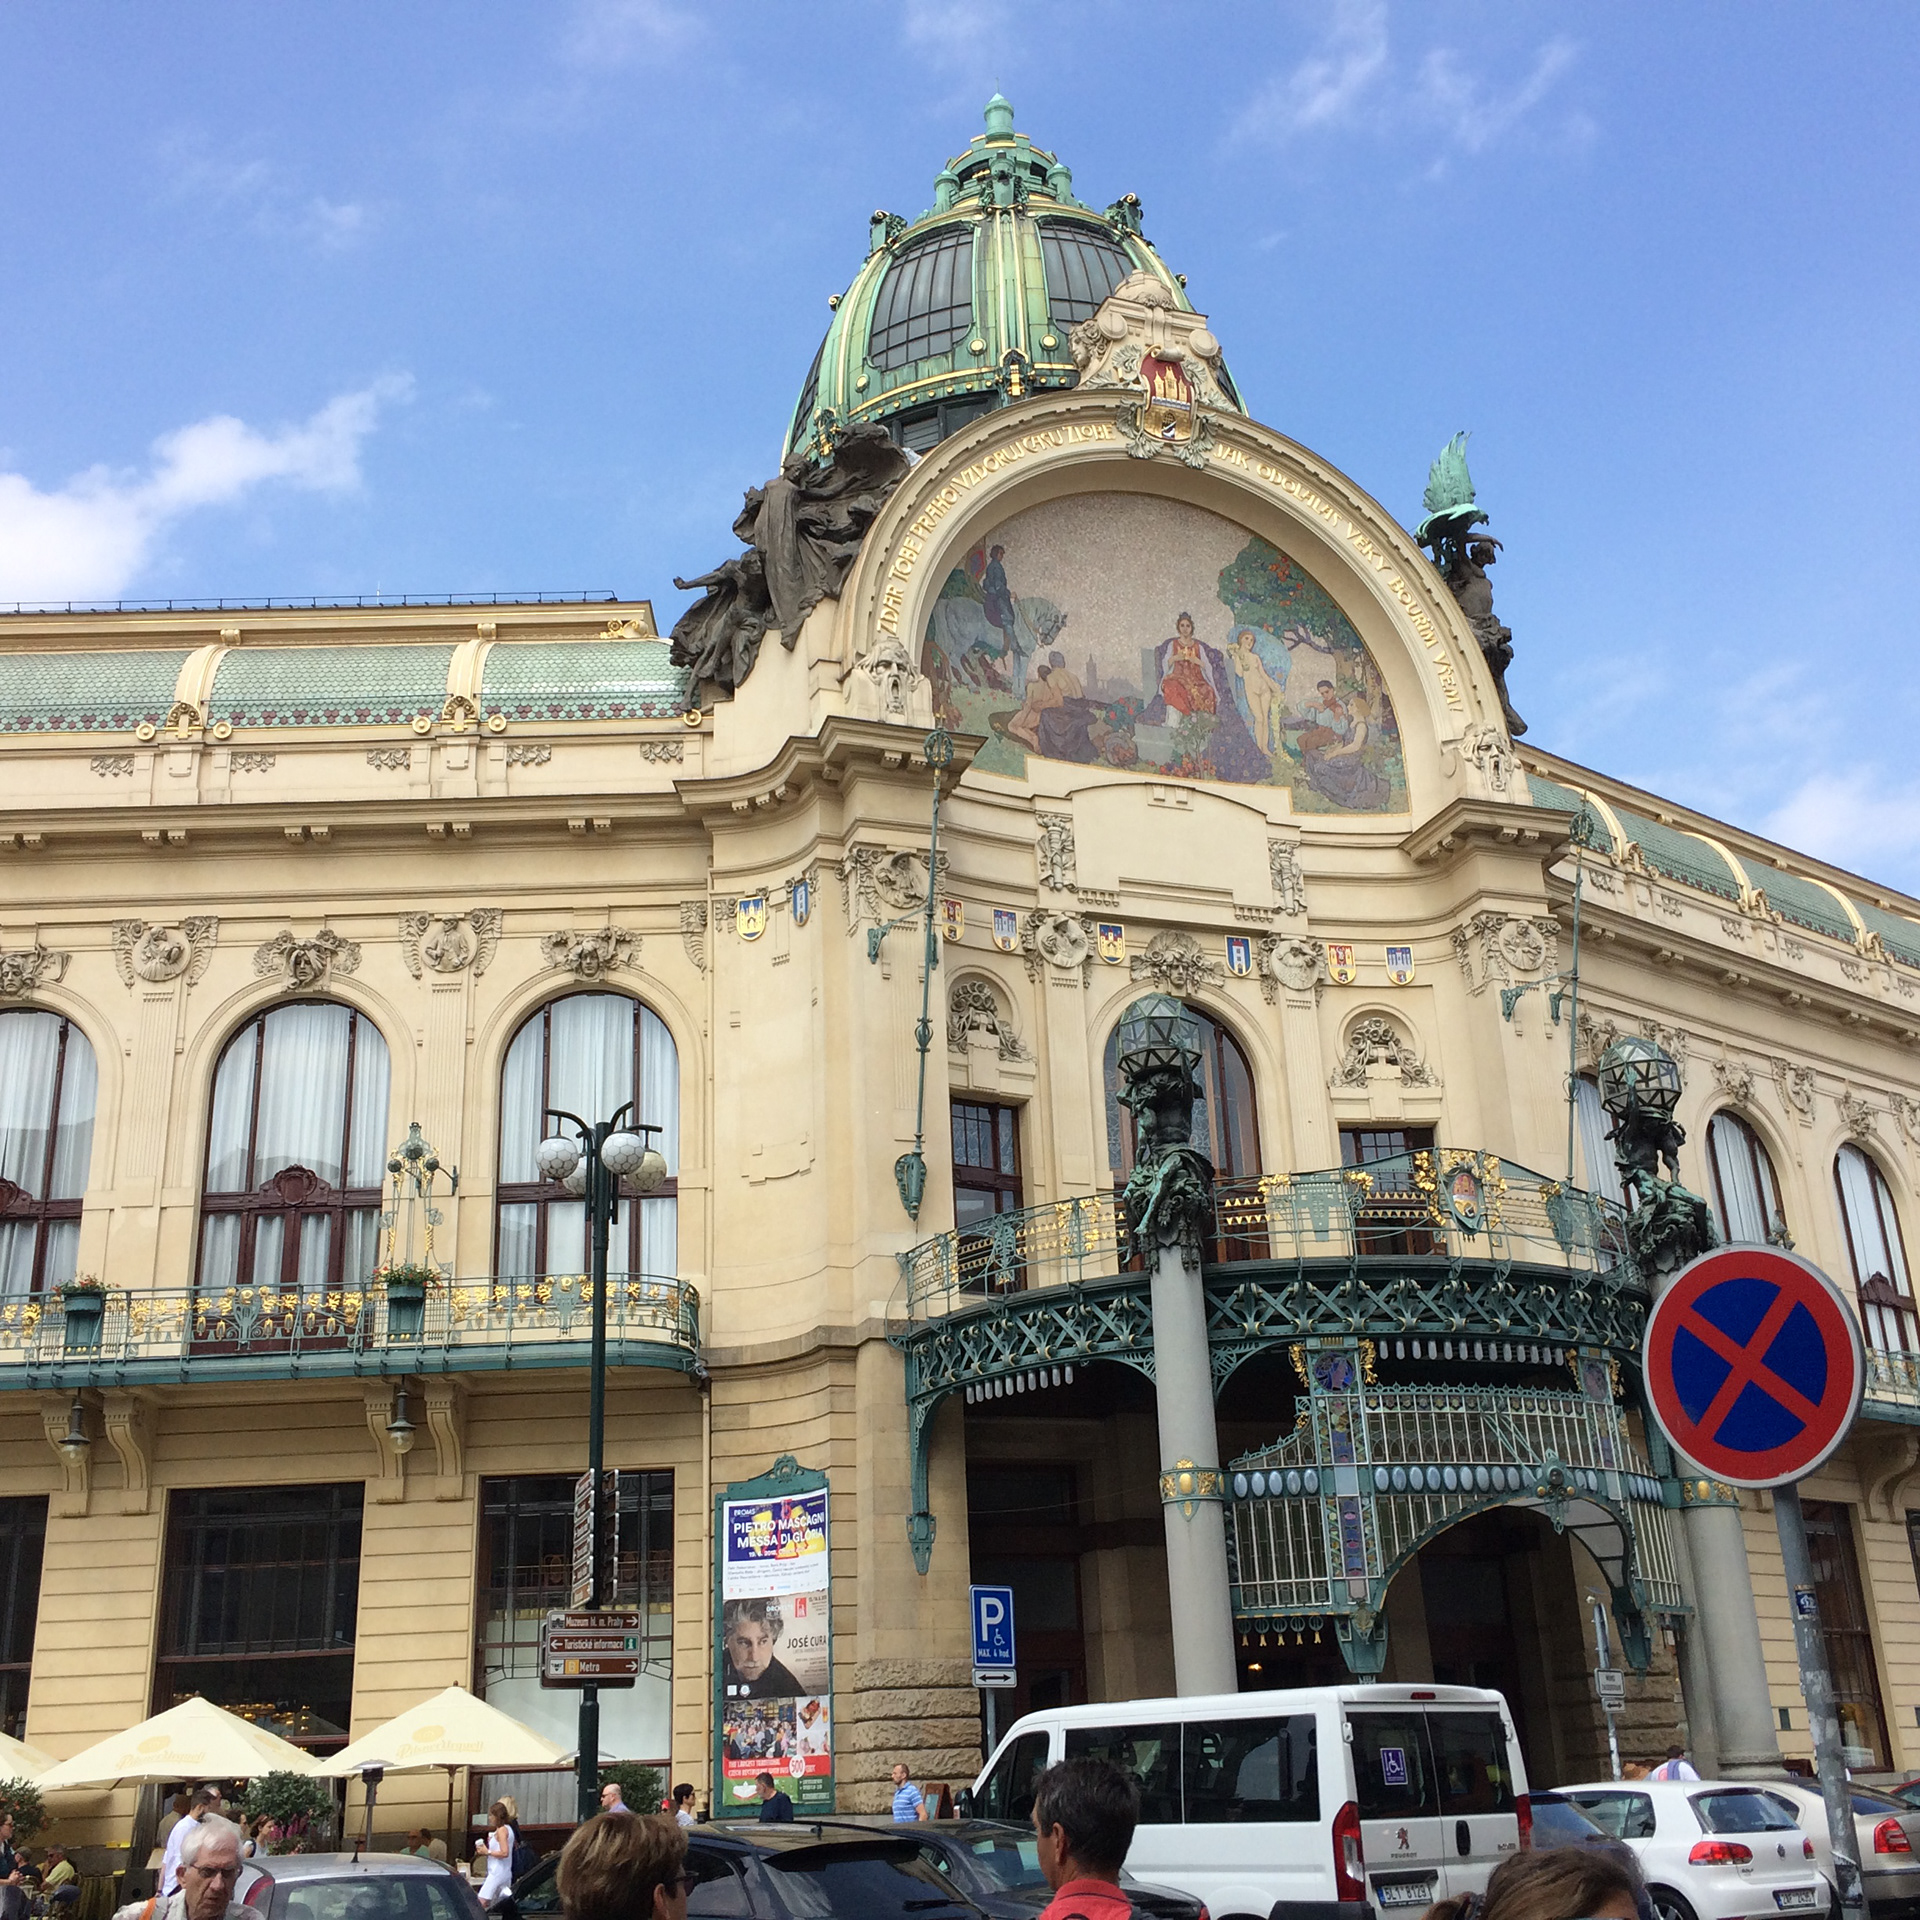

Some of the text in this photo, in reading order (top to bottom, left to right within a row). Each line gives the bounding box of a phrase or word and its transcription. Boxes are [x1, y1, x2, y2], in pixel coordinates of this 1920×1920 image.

[1212, 442, 1251, 472] JAK
[1256, 462, 1344, 528] ODOLALAS
[877, 582, 904, 636] ZDAR
[733, 1512, 825, 1534] PIETRO MASCAGNI
[737, 1534, 779, 1549] MESSA
[781, 1533, 791, 1545] DI
[792, 1527, 823, 1543] GLORIA
[565, 1616, 589, 1627] Muzeum
[607, 1616, 624, 1629] Prahy
[981, 1597, 1005, 1642] P
[564, 1639, 624, 1650] Turistické informace
[787, 1634, 827, 1649] JOSÉ CURA
[568, 1661, 600, 1673] B Metro
[791, 1760, 804, 1773] 500
[1406, 1884, 1427, 1899] 8129
